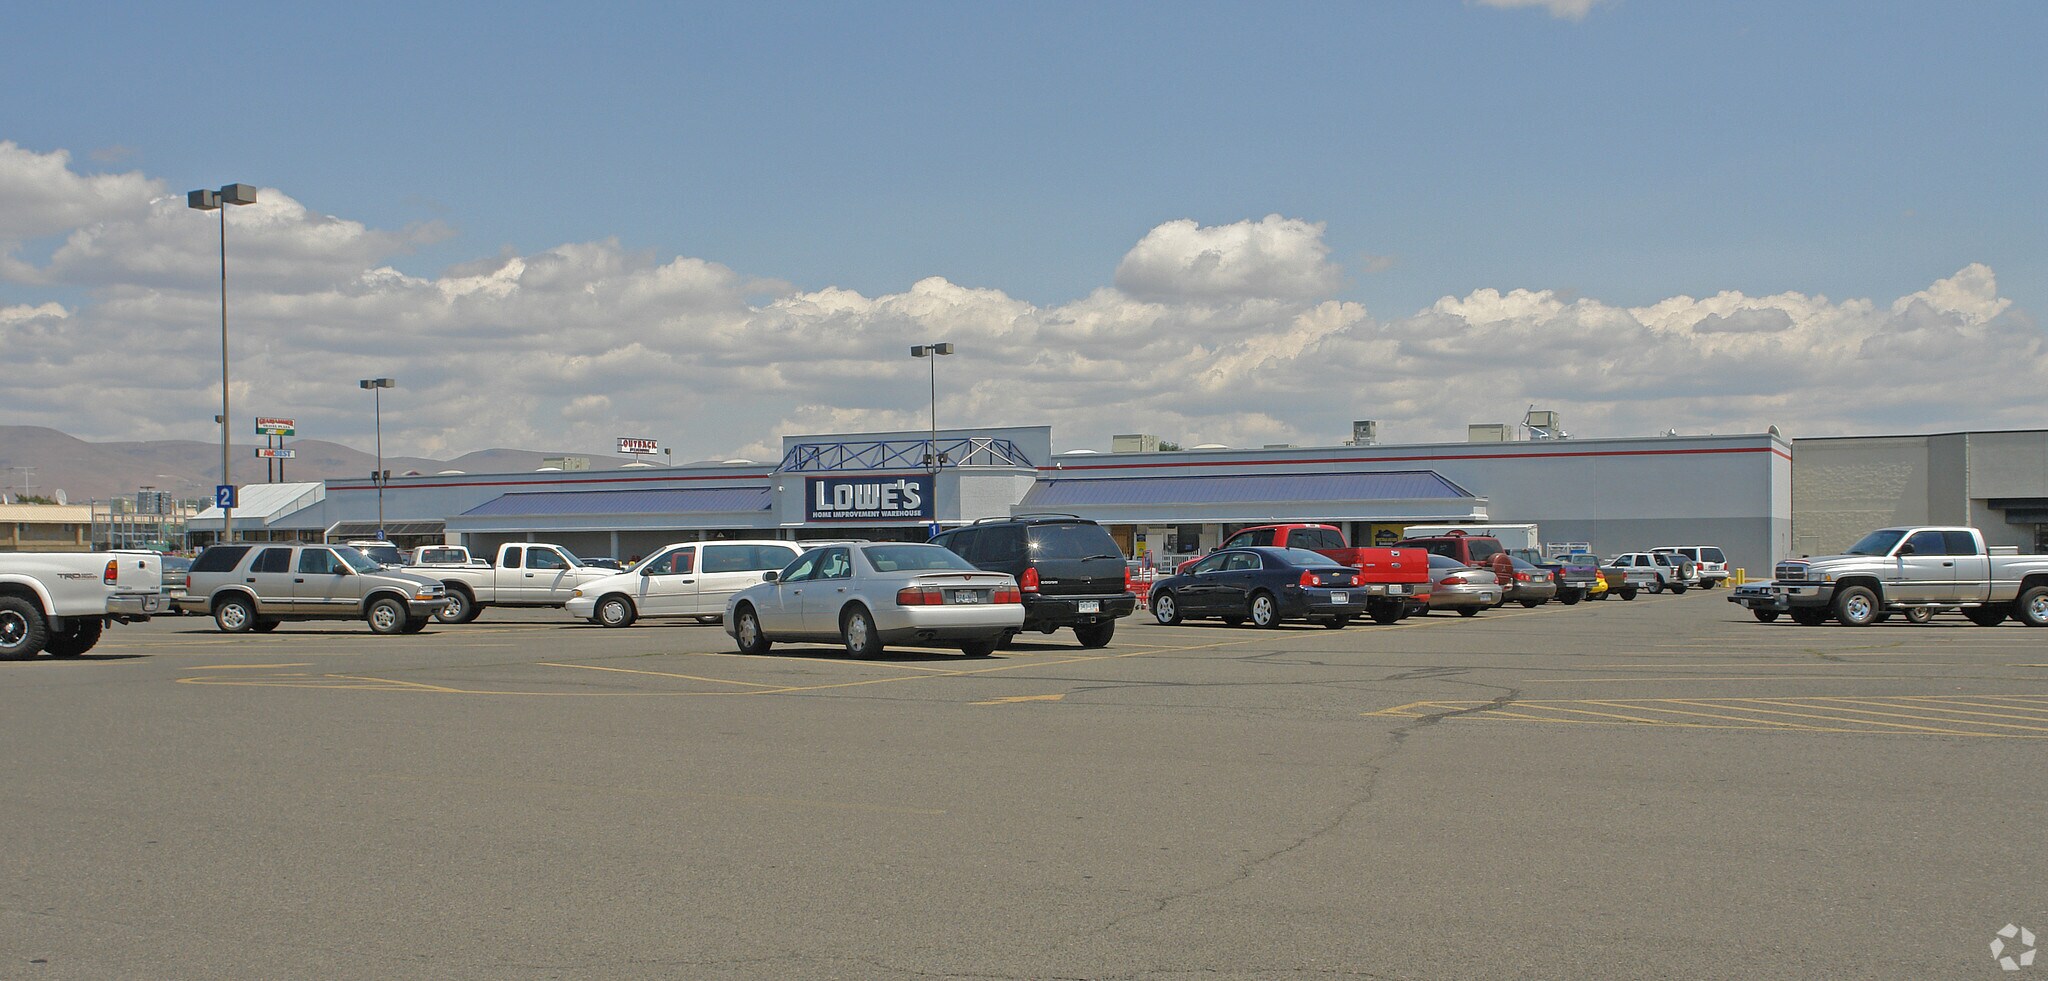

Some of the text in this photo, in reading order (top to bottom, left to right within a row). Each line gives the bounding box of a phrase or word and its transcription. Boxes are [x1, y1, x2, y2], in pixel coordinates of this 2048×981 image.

[623, 440, 657, 449] OUTBACK
[220, 488, 230, 505] 2
[816, 479, 922, 510] LOWE'S
[931, 525, 936, 535] 1
[378, 531, 383, 540] 3
